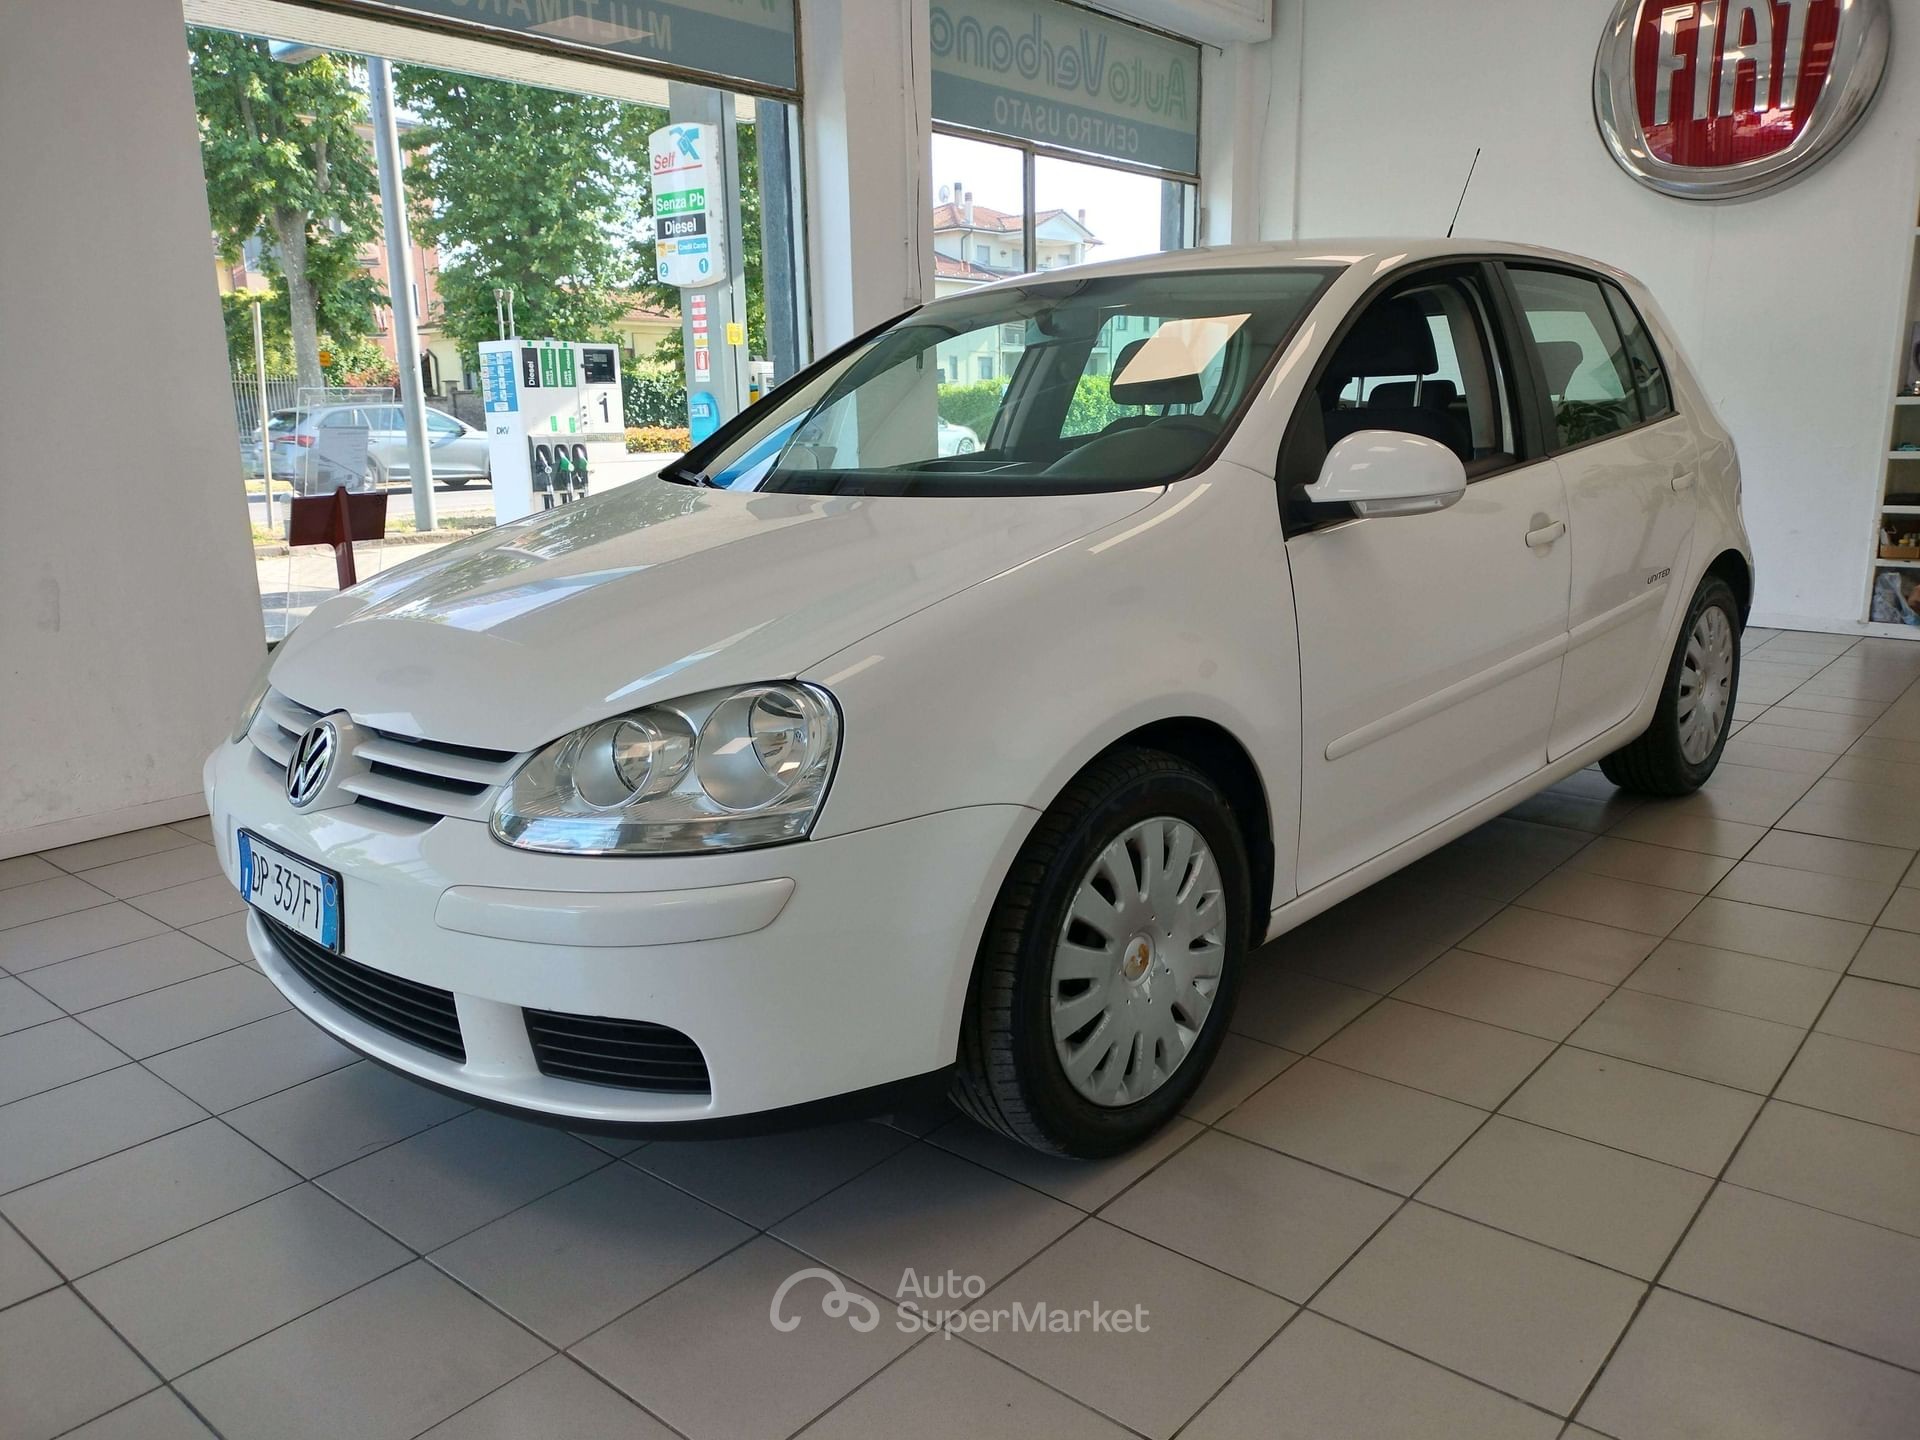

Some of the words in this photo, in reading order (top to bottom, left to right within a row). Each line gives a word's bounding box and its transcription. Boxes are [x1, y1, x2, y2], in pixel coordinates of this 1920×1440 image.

[1654, 0, 1823, 126] FIAT
[654, 152, 675, 170] Self
[656, 197, 687, 212] Senza
[689, 191, 704, 208] Pb
[664, 217, 697, 235] Diesel
[528, 360, 536, 386] Diesel
[496, 426, 509, 435] DKV
[1647, 567, 1670, 584] UNITED
[251, 850, 269, 896] DP
[274, 863, 321, 930] 337FT
